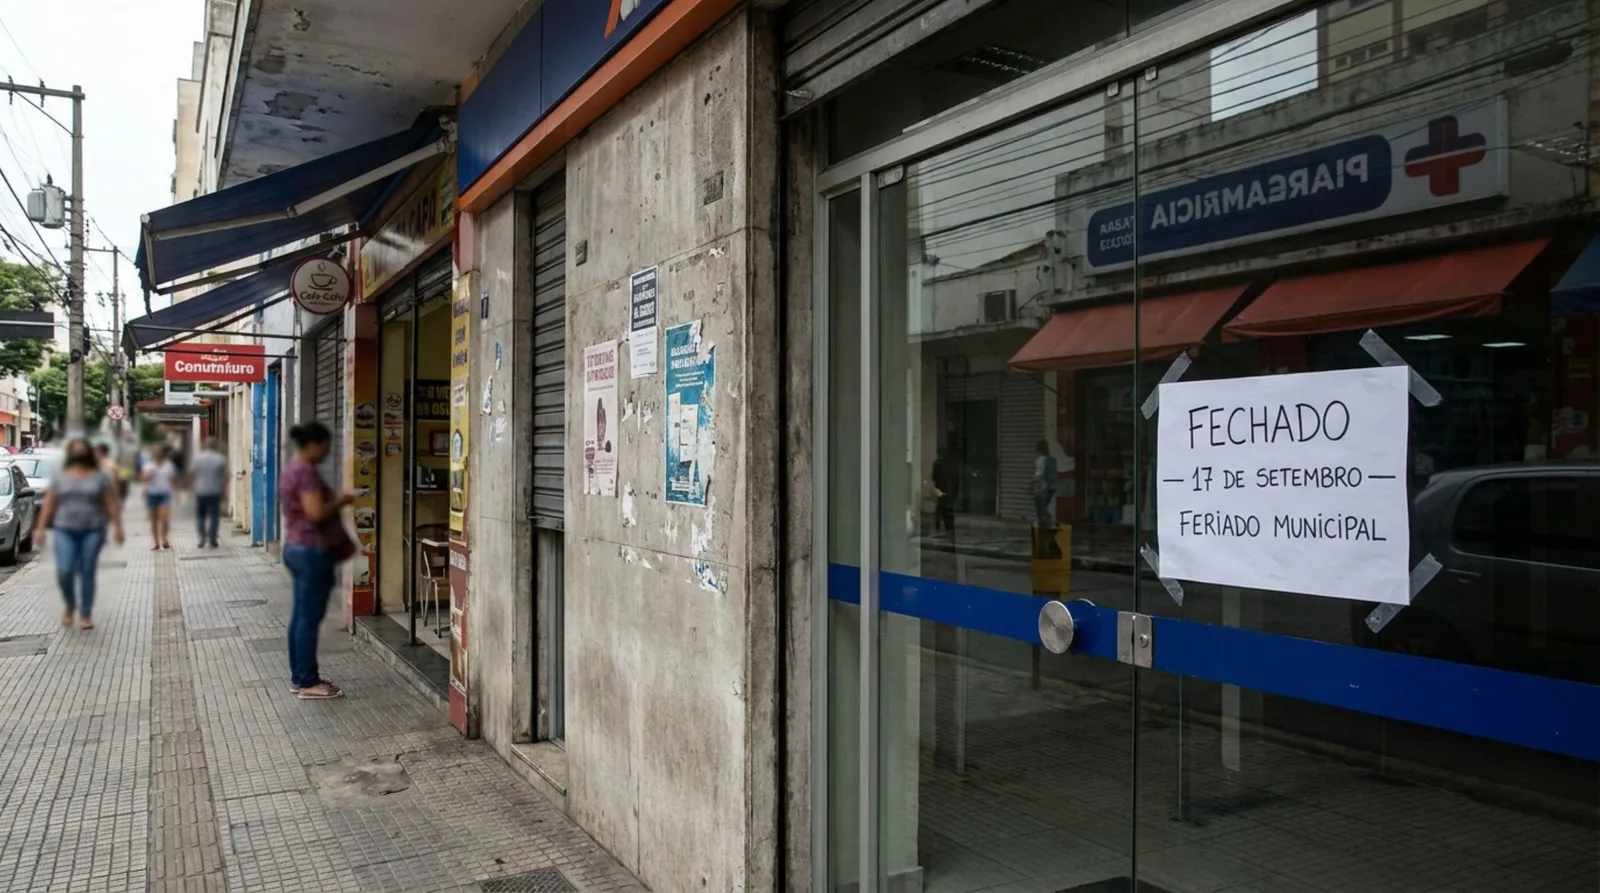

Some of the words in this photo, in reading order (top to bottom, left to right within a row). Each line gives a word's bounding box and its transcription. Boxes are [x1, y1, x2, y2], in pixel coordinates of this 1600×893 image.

[1189, 400, 1350, 449] FECHADO
[1192, 466, 1213, 492] 17
[1223, 469, 1245, 490] DE
[1256, 466, 1362, 489] SETEMBRO
